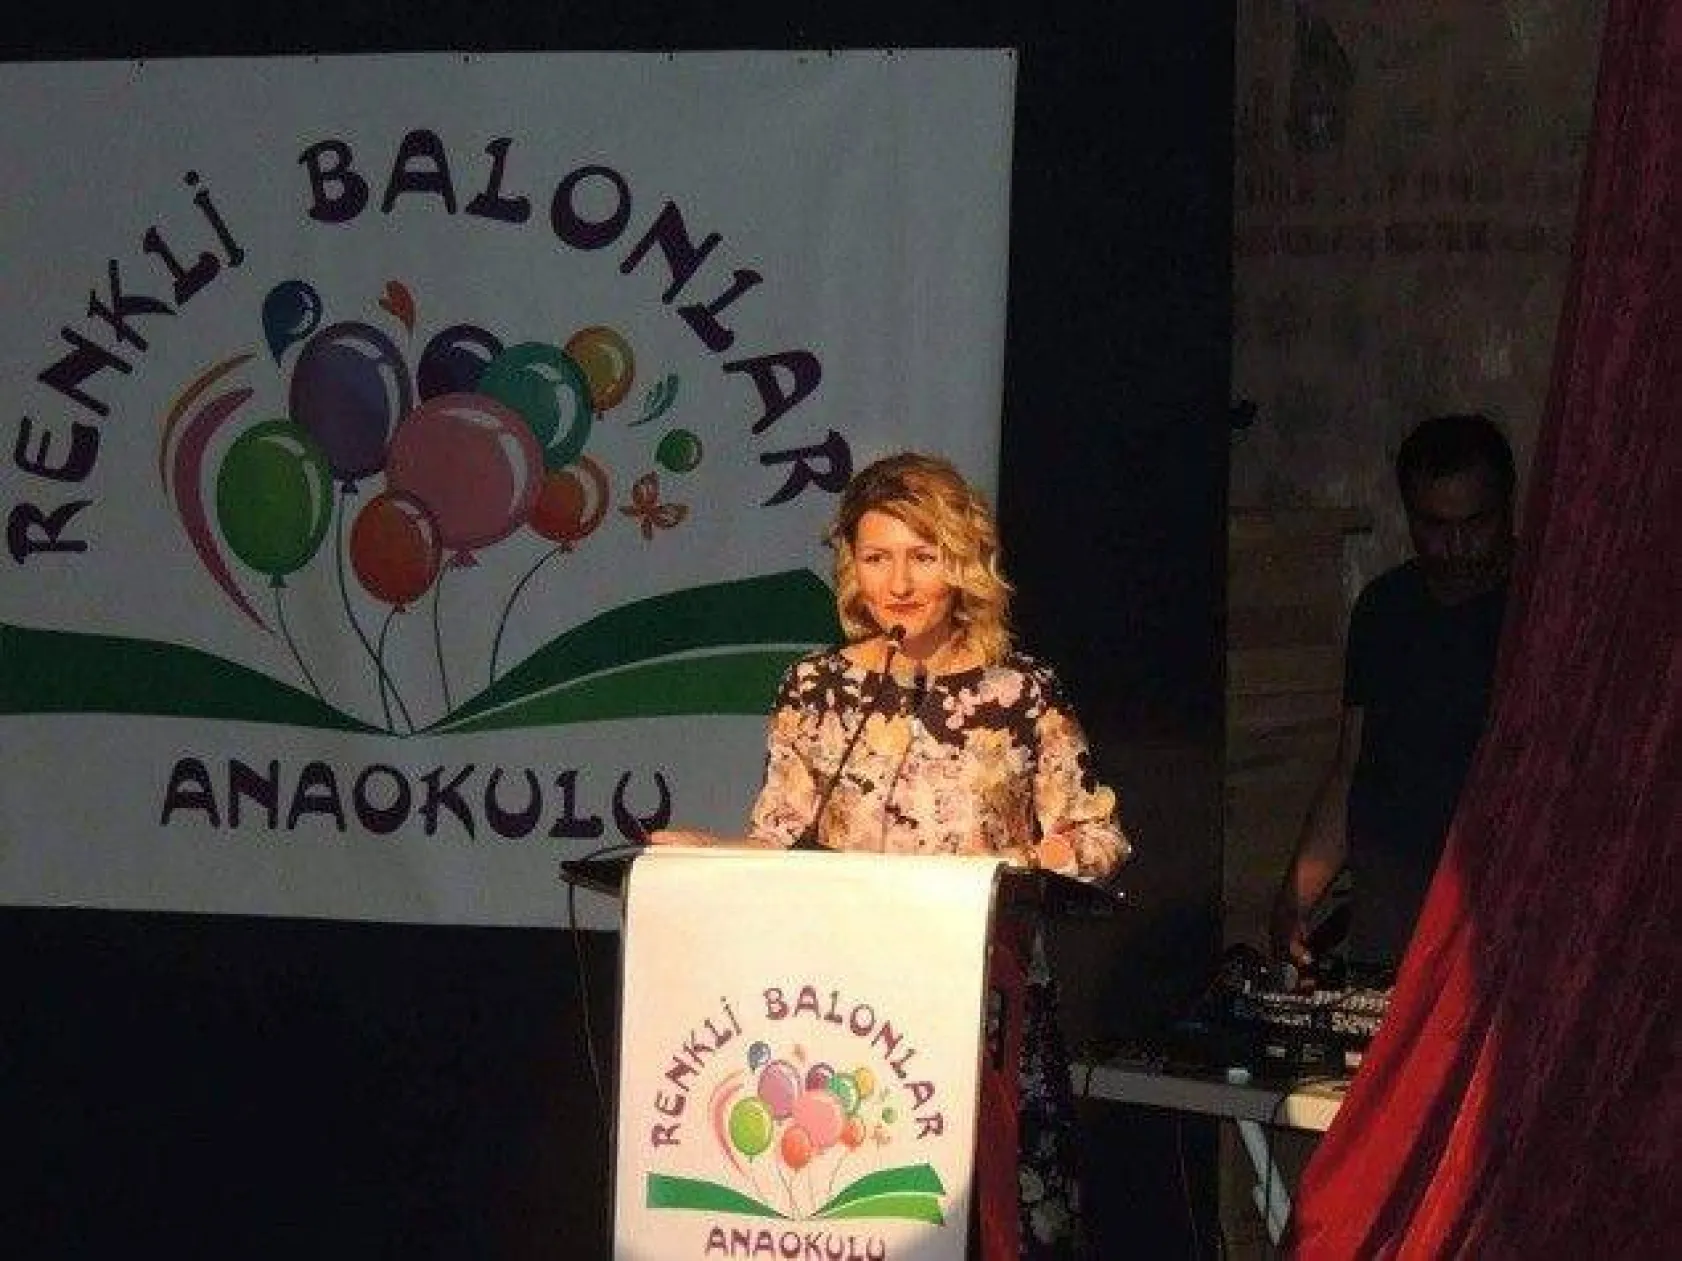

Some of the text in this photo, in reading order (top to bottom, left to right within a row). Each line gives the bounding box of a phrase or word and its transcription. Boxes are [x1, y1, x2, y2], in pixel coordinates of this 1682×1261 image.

[297, 128, 853, 508] BALONLAR
[160, 757, 672, 844] ANAOKULU
[763, 985, 944, 1139] BALONLAR
[705, 1225, 886, 1261] ANAOKULU
